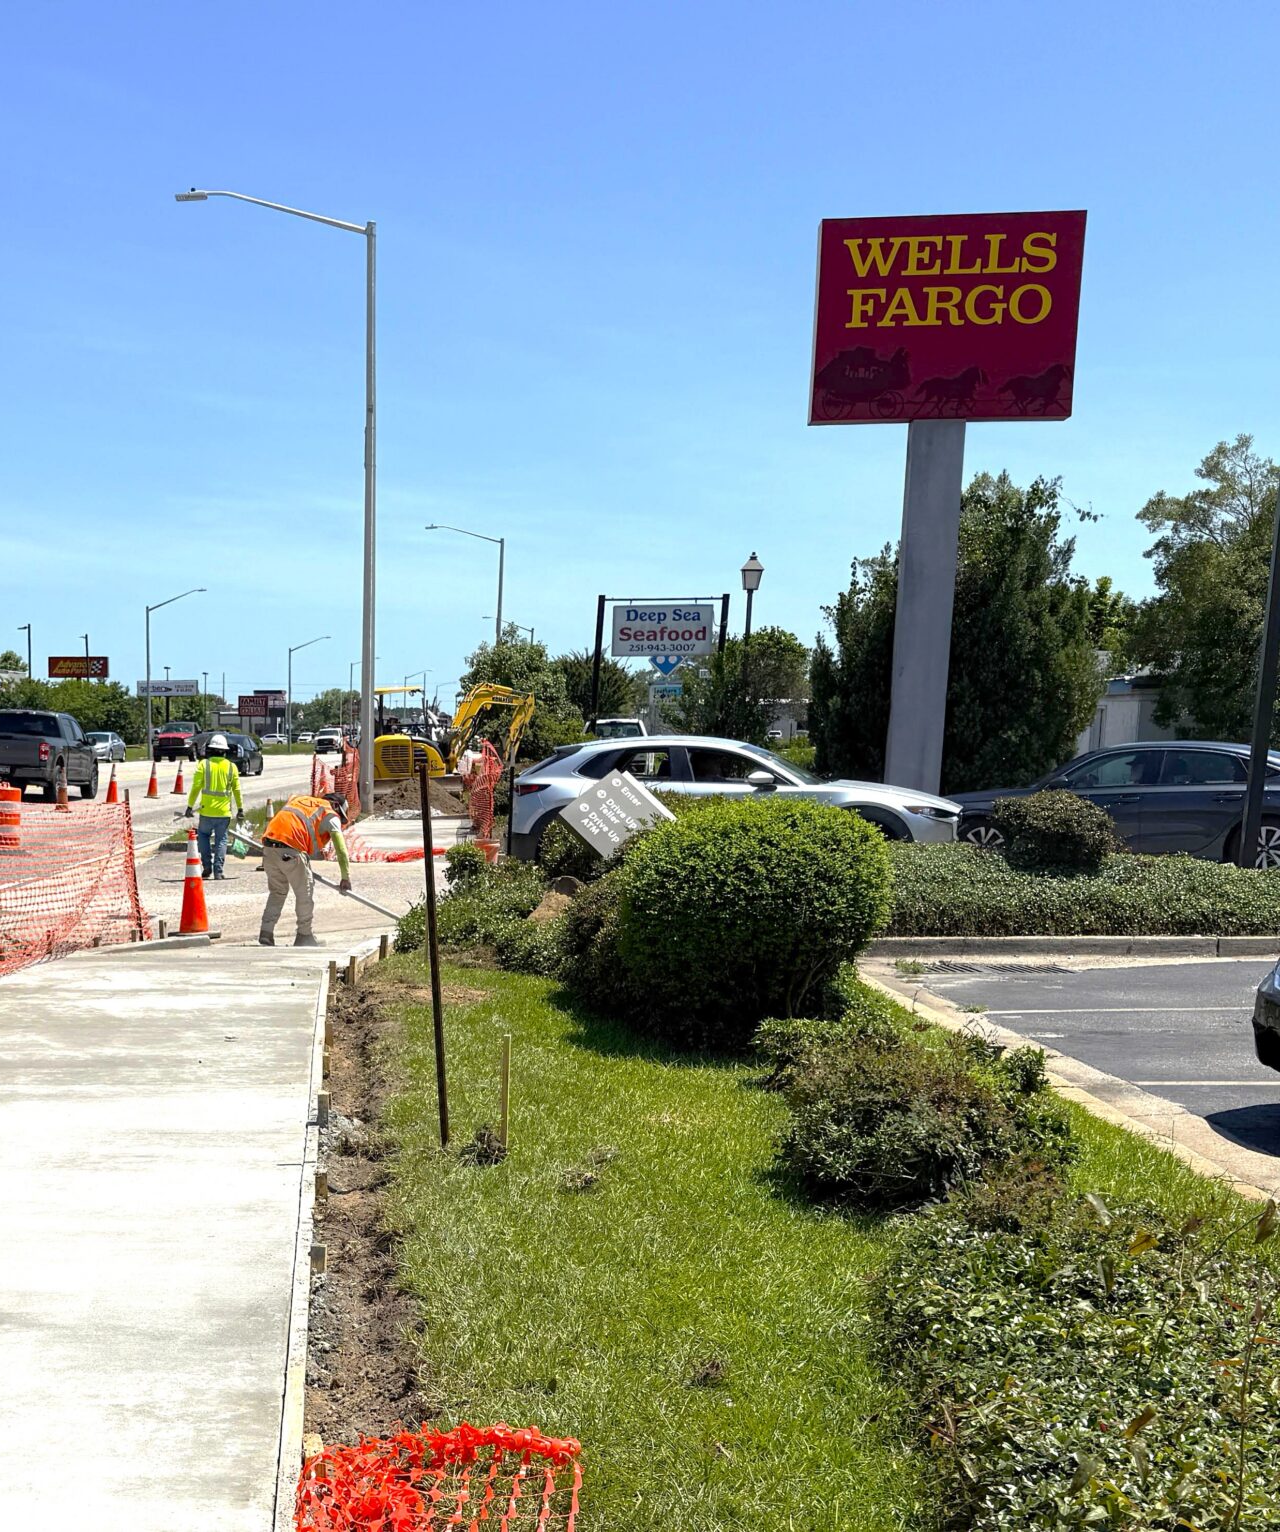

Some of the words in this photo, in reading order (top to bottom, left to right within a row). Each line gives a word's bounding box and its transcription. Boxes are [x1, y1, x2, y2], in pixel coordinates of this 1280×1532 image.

[843, 232, 1058, 277] WELLS
[845, 284, 1052, 328] FARGO
[626, 609, 667, 624] Deep
[672, 608, 701, 622] Sea
[619, 626, 707, 642] Seafood
[628, 643, 696, 652] 251-943-3007
[621, 787, 642, 807] Enter
[599, 804, 621, 825] Teller
[606, 798, 627, 819] Drive
[625, 816, 638, 830] Up
[581, 818, 600, 836] ATM
[589, 812, 609, 832] Drive
[608, 830, 620, 843] Up
